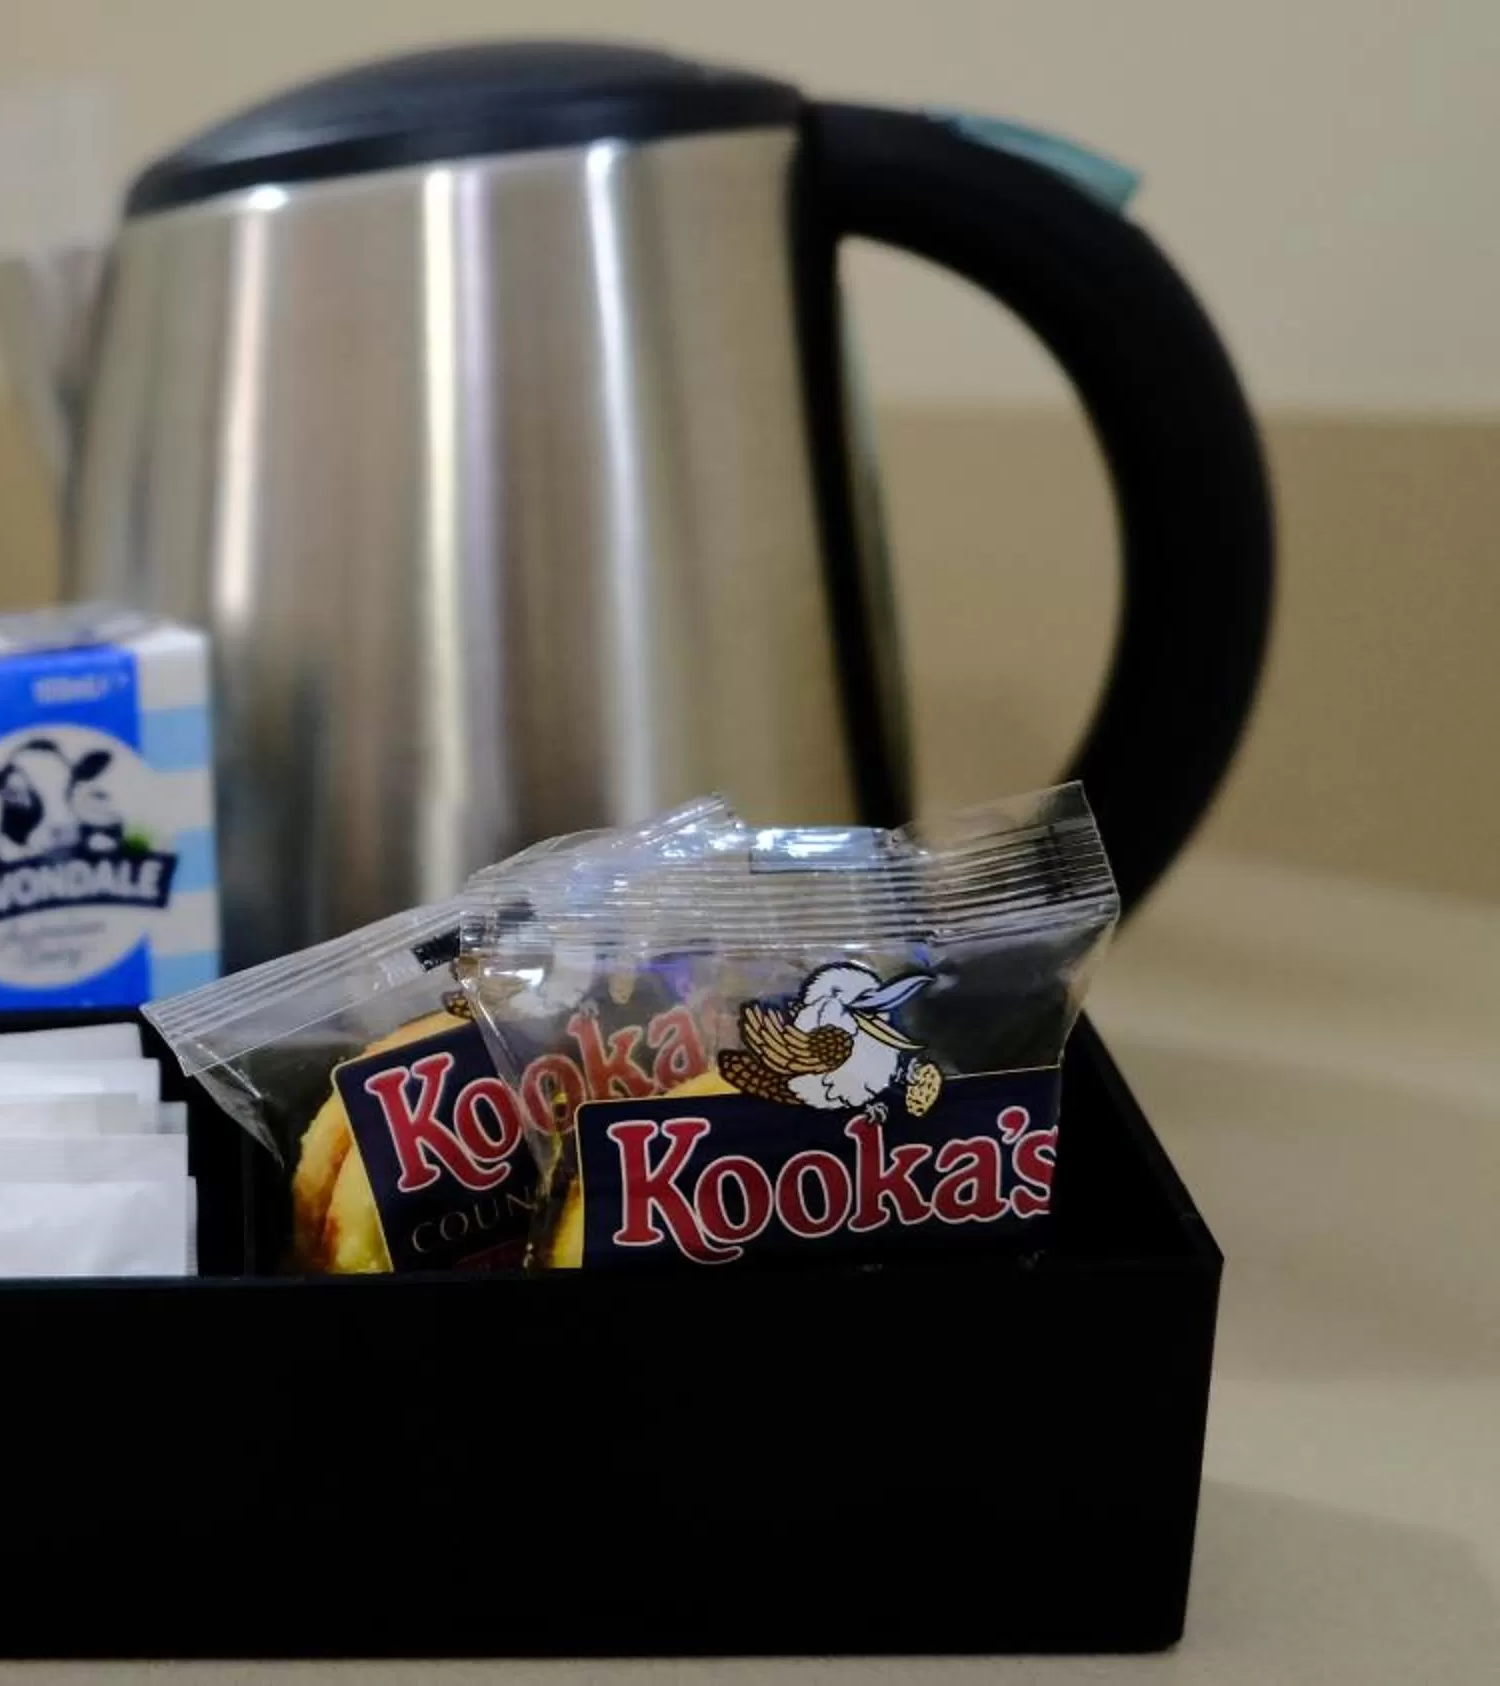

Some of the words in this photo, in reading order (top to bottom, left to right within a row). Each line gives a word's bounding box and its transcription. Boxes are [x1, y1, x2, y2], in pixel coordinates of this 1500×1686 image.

[364, 1004, 709, 1190] Kooka
[411, 1184, 540, 1254] COUN
[607, 1106, 1059, 1264] Kooka's
